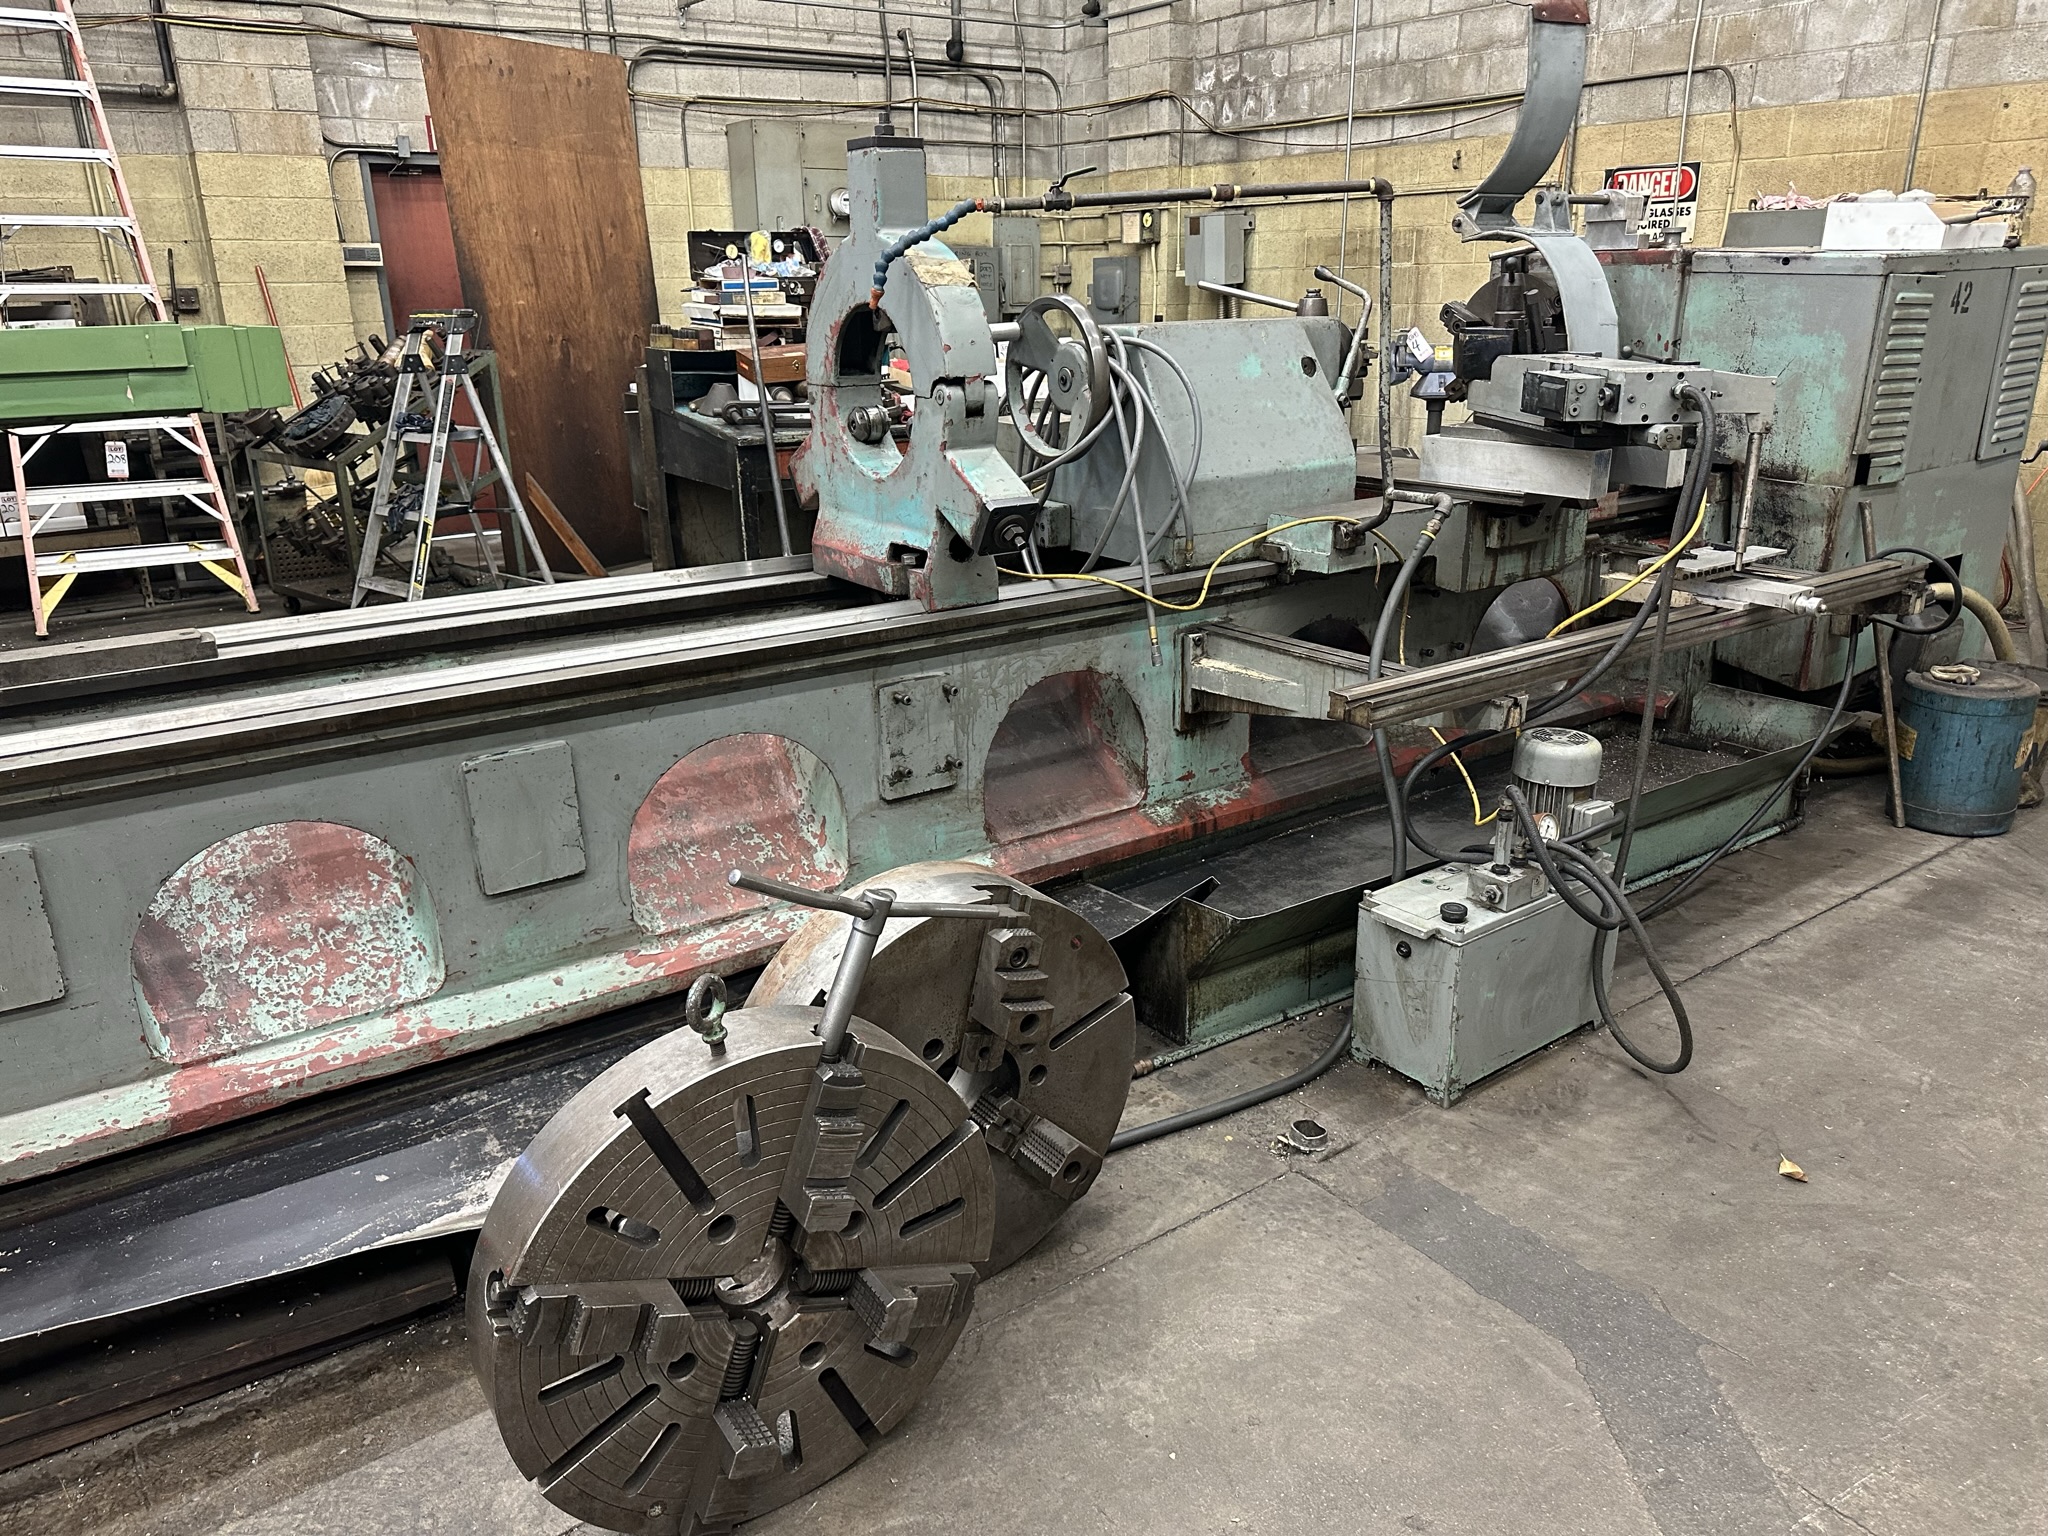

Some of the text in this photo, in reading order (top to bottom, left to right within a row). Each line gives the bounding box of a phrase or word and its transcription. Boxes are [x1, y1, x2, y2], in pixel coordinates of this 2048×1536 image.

[1616, 171, 1683, 197] DANGER
[1637, 219, 1671, 230] UIRED
[1950, 281, 1973, 315] 42
[1411, 339, 1421, 352] 4
[107, 453, 127, 464] 208
